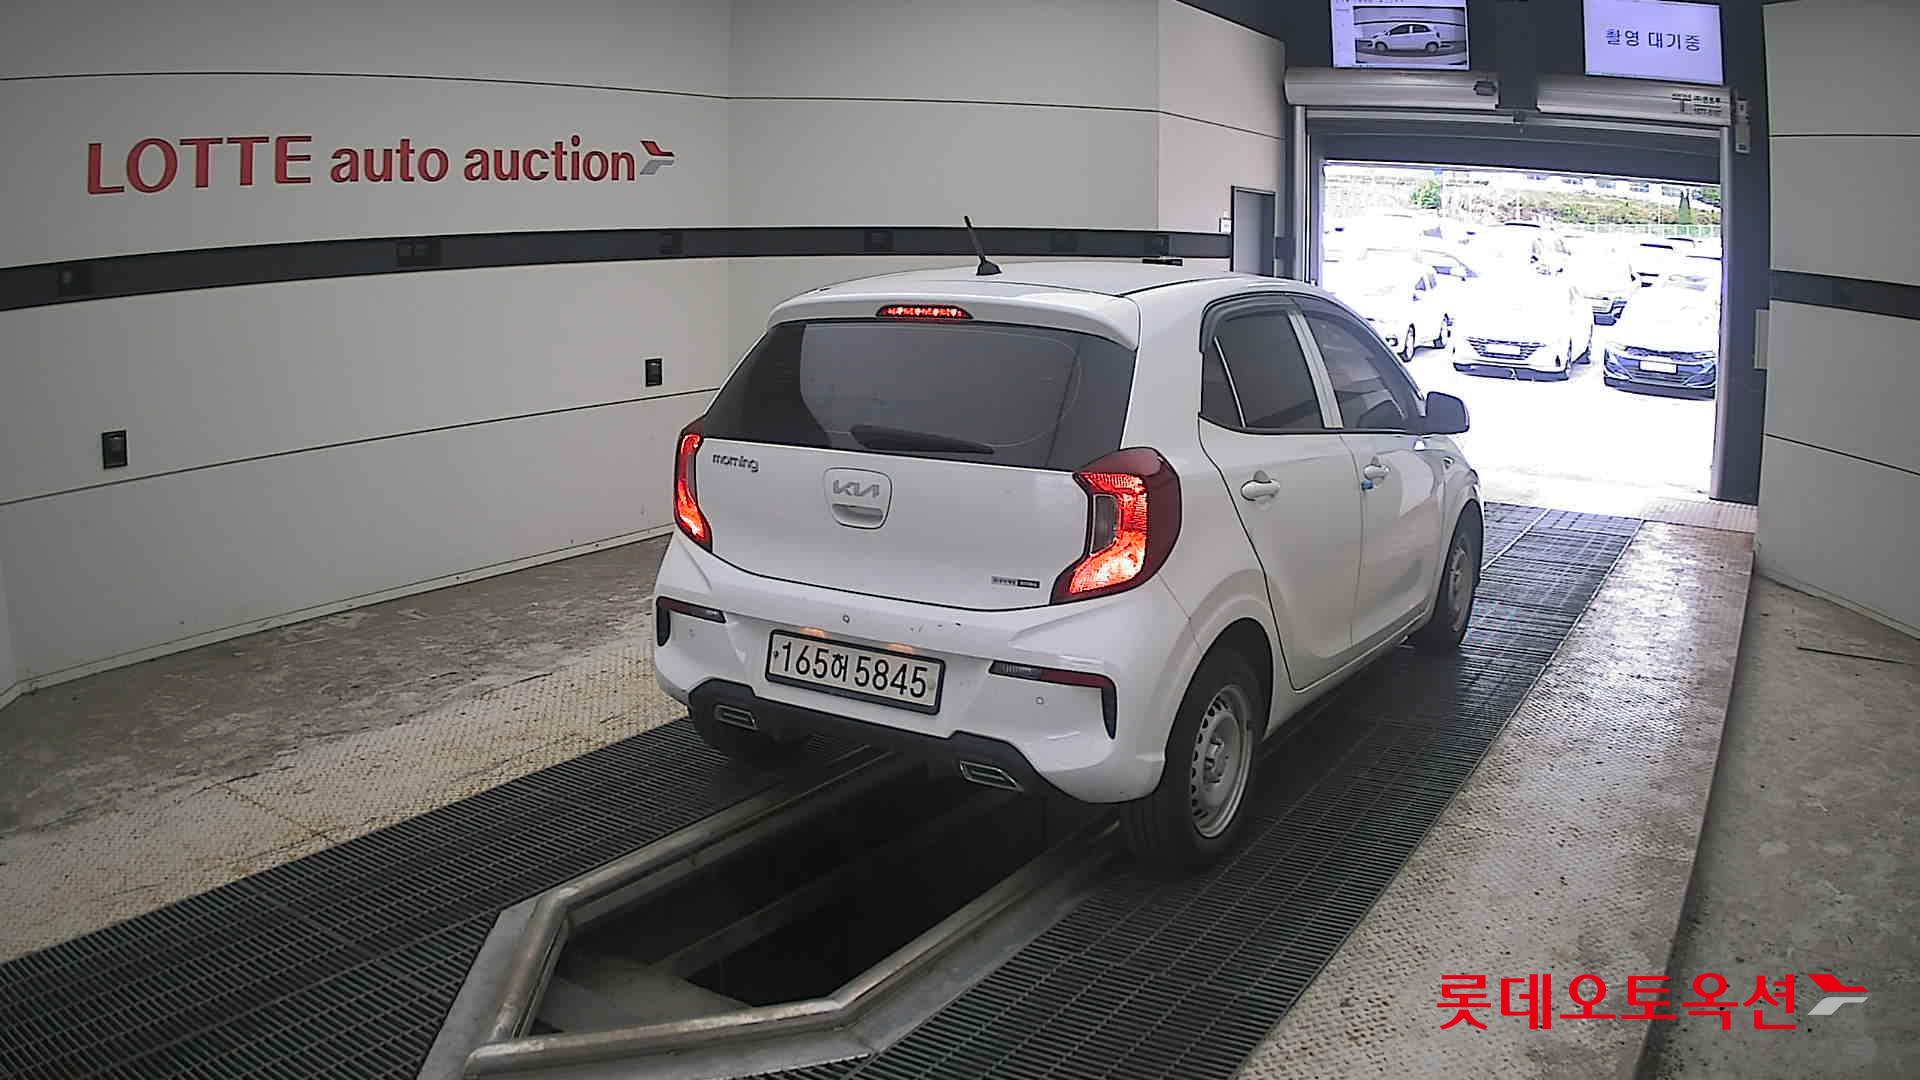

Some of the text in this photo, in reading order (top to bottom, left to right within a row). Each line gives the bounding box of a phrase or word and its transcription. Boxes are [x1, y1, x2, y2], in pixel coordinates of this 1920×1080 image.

[1647, 31, 1701, 52] 대기중
[87, 134, 636, 195] LOTTE auto auction
[711, 453, 760, 473] morning
[854, 655, 928, 699] 5845
